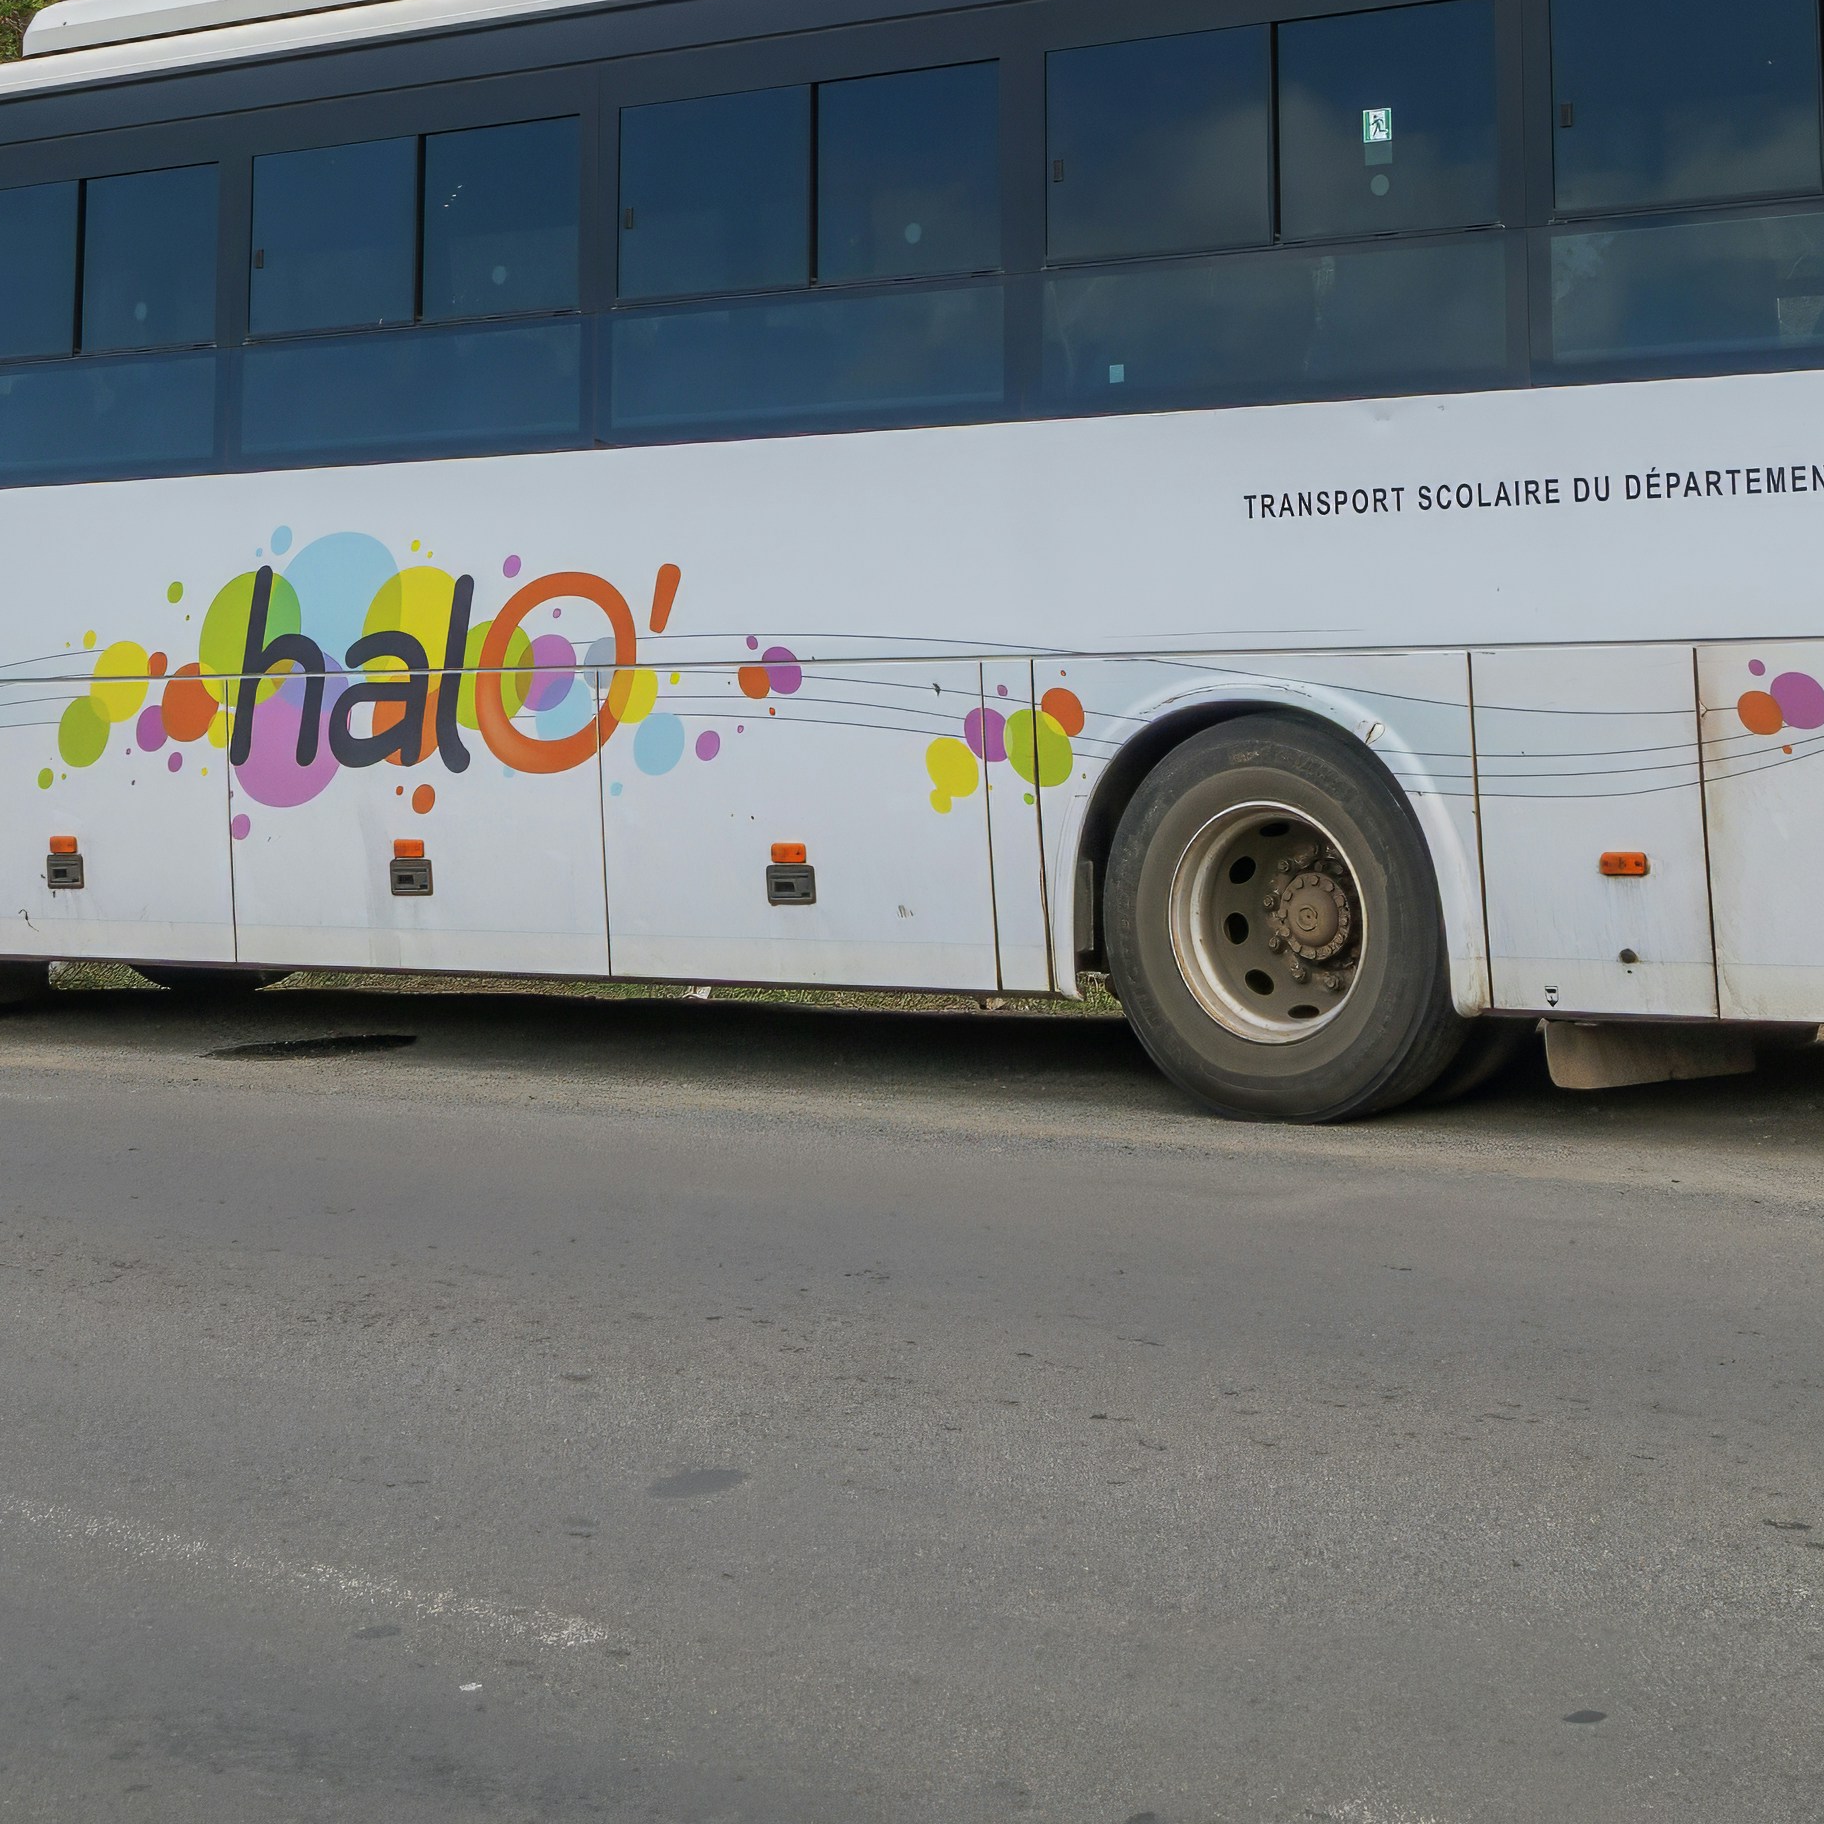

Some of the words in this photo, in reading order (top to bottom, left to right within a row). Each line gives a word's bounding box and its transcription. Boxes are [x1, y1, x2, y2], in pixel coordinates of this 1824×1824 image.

[1243, 486, 1405, 520] TRANSPORT
[1417, 478, 1561, 511] SCOLAIRE
[1573, 475, 1611, 503] DU
